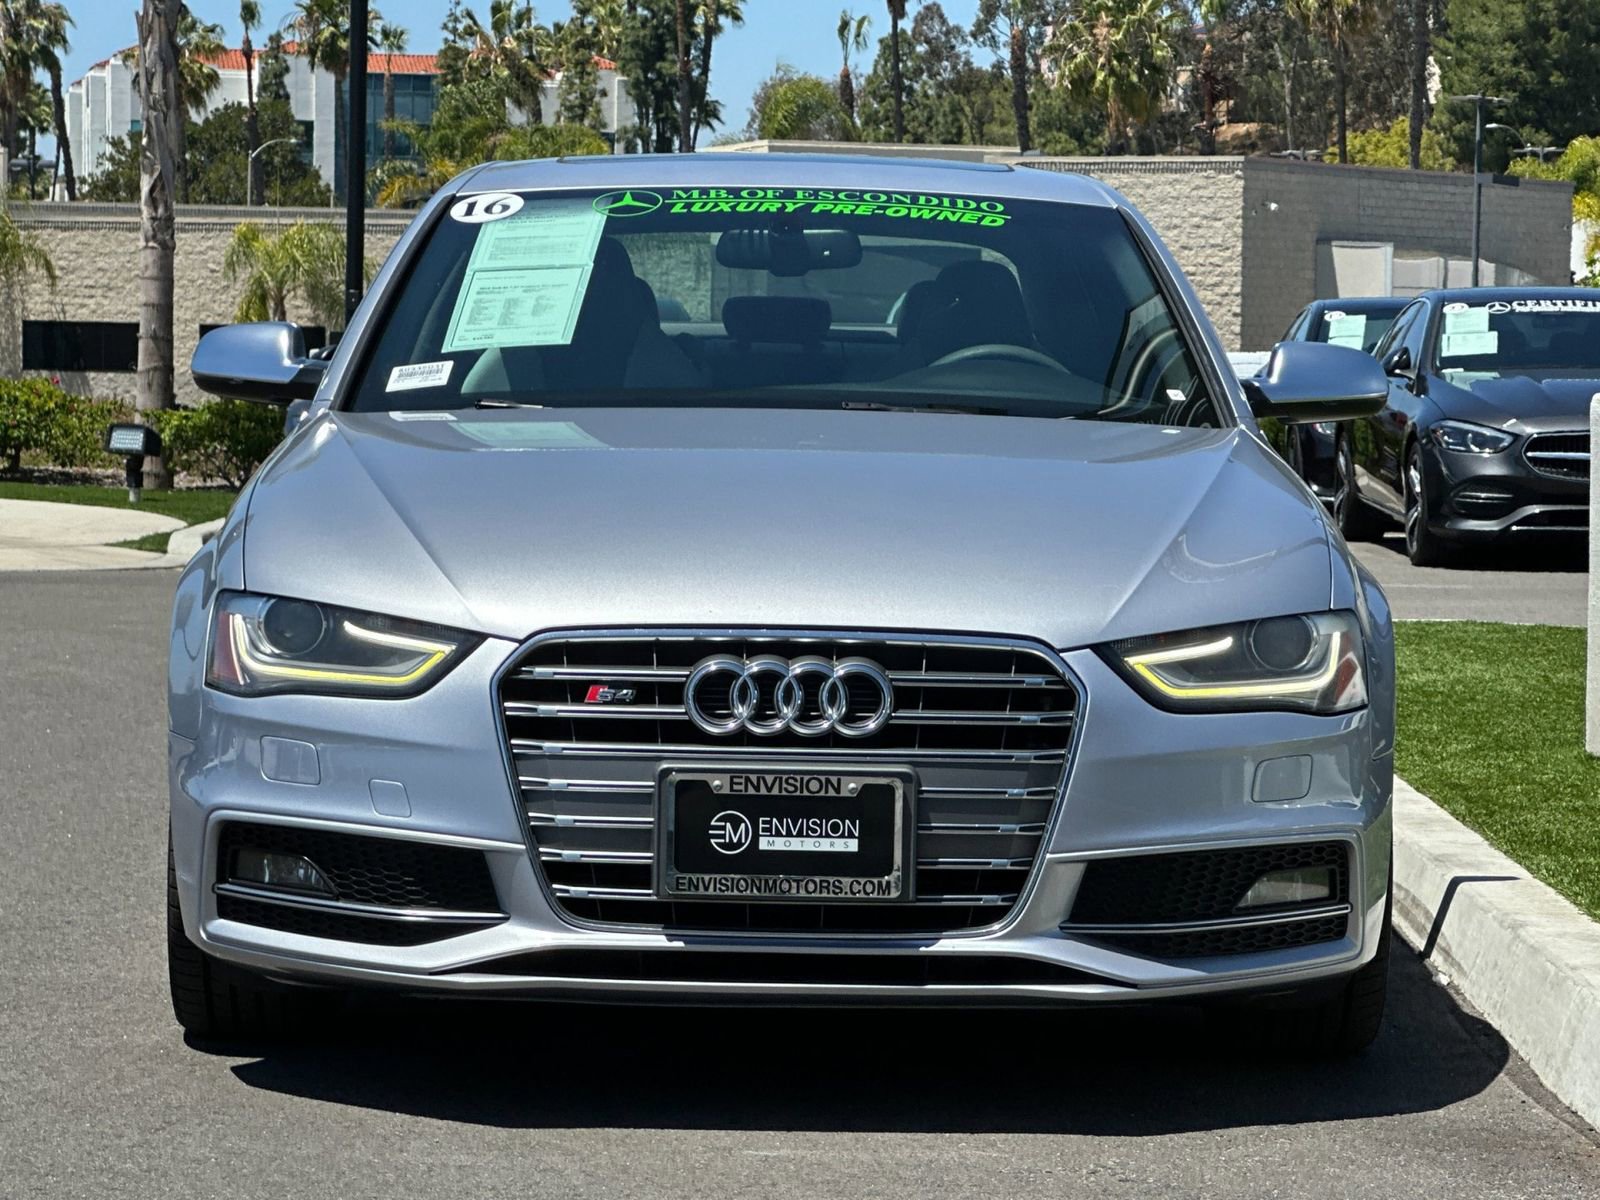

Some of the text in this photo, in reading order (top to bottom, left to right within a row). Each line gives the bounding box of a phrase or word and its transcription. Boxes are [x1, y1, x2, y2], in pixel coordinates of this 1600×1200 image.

[462, 196, 513, 217] 16
[740, 189, 783, 199] OF
[794, 189, 1005, 213] ESCONDIDO
[670, 201, 1005, 227] LUXURY PRE-OWNED
[594, 687, 635, 703] S4
[729, 774, 842, 795] ENVISION
[758, 817, 860, 838] ENVISION
[766, 839, 849, 849] MOTORS
[675, 875, 892, 896] ENVISIONMOTORS.COM
